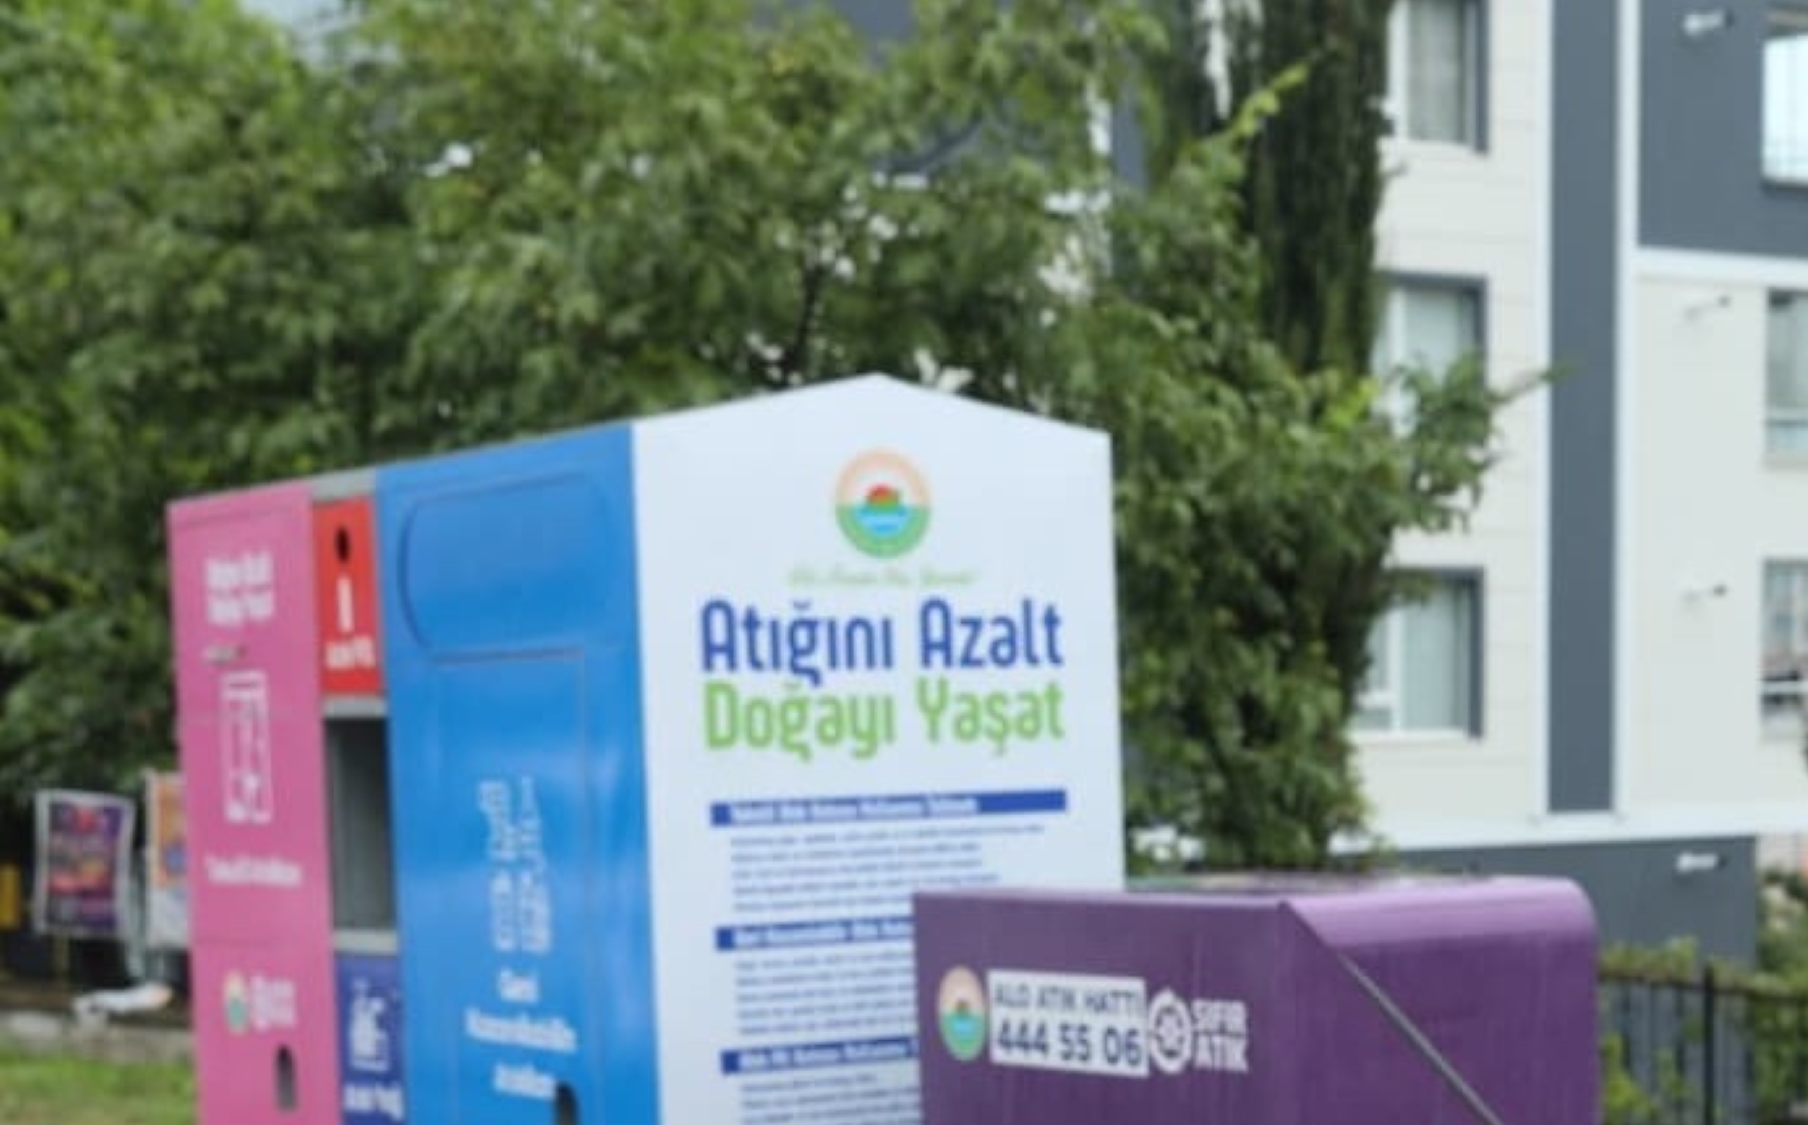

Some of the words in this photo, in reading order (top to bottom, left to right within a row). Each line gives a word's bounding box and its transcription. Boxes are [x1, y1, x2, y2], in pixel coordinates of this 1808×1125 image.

[701, 597, 894, 687] Atığını
[919, 595, 1064, 671] Azalt
[704, 679, 896, 763] Doğayı
[916, 675, 1065, 757] Yaşat
[998, 1018, 1048, 1059] 444
[1058, 1023, 1092, 1062] 55
[1103, 1026, 1142, 1066] 06
[1194, 1034, 1249, 1074] ATIK
